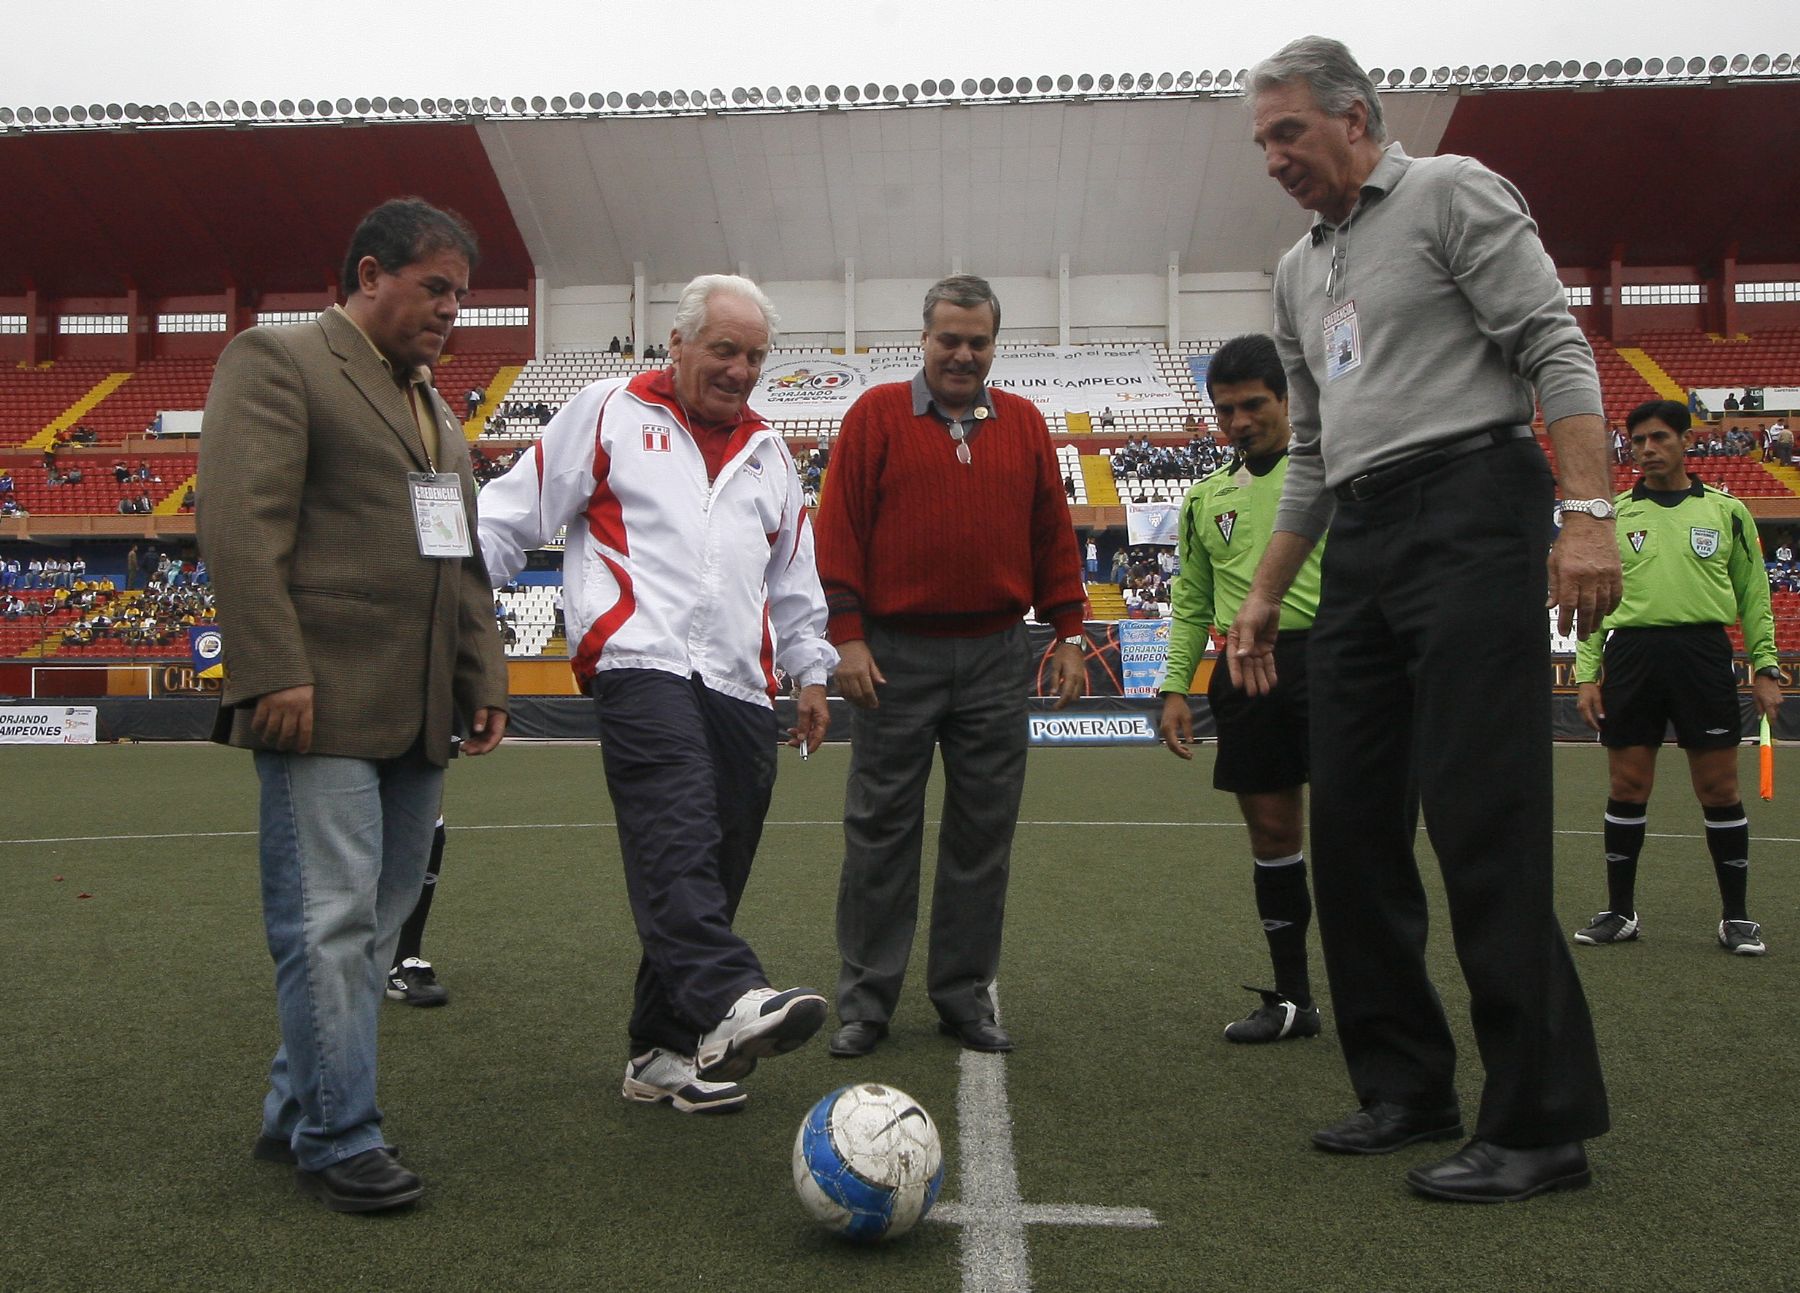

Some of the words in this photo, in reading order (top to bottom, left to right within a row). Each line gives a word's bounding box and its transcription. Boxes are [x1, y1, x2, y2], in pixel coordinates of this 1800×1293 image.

[1021, 378, 1047, 387] UN
[415, 486, 459, 500] CREDENCIAL
[1123, 653, 1168, 662] CAMPEON
[0, 715, 48, 724] ORJANDO
[0, 726, 61, 736] AMPEONES
[1033, 720, 1146, 736] POWERADE
